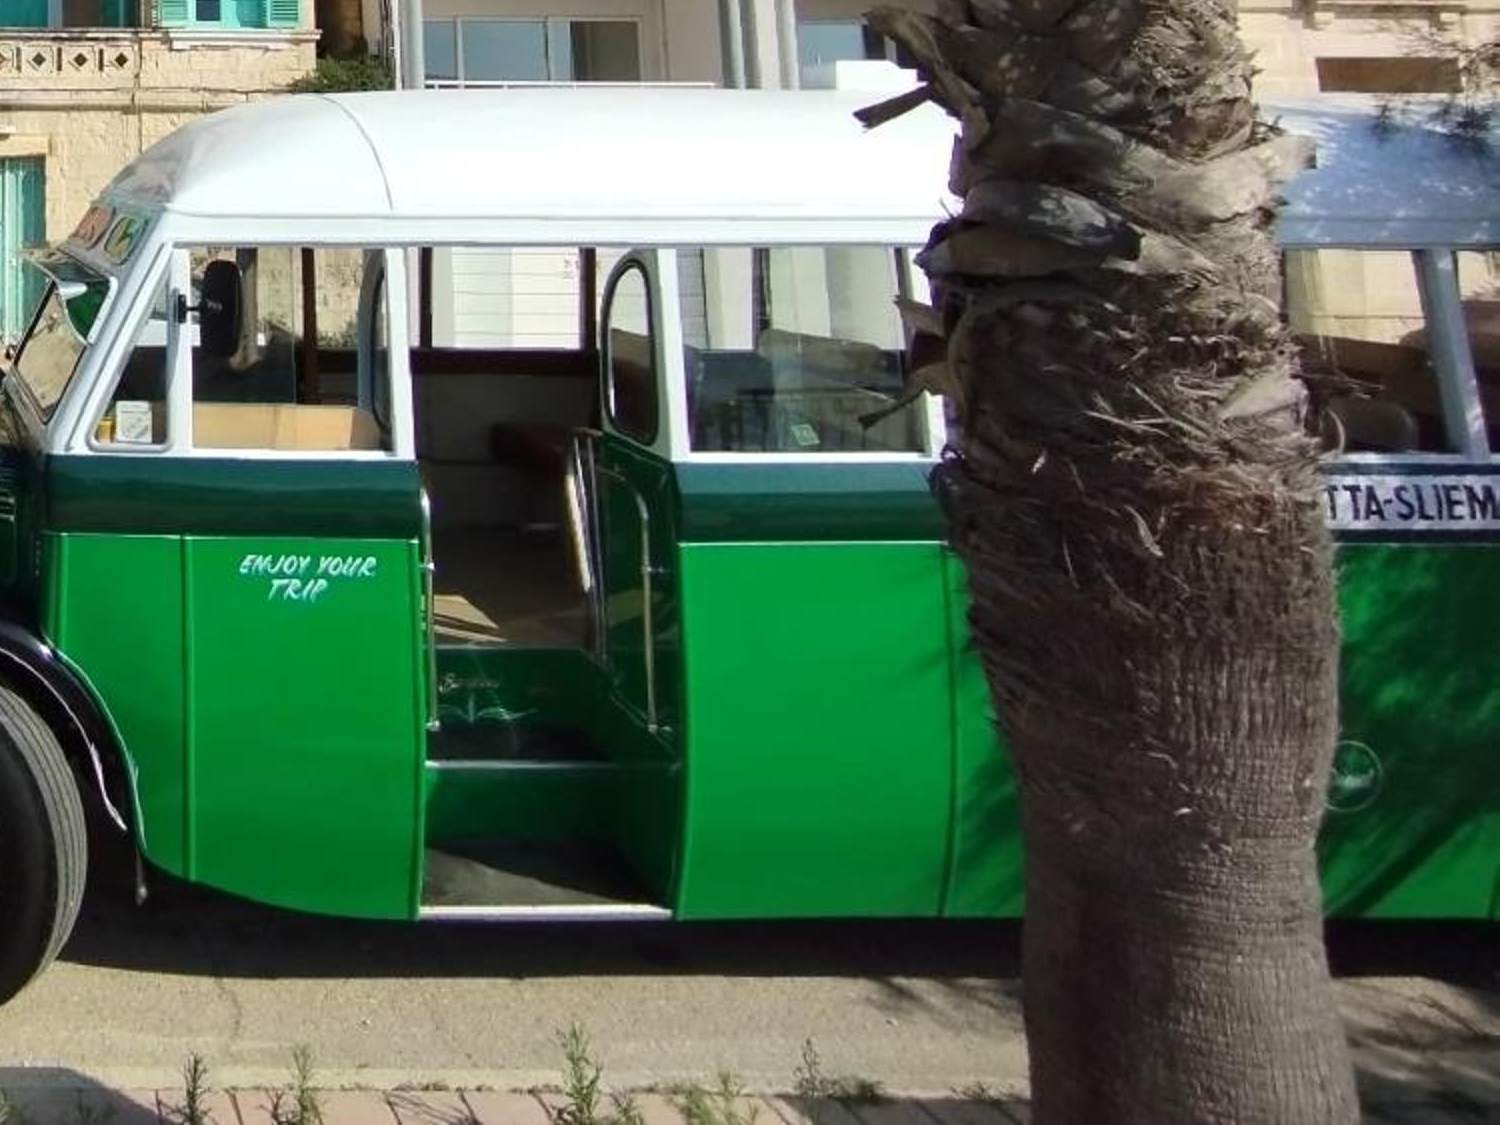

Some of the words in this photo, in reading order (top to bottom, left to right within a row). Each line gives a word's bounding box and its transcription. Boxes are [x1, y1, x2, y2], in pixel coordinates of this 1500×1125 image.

[239, 554, 311, 574] ENJOY
[316, 555, 377, 577] YOUR
[267, 578, 329, 602] TRIP
